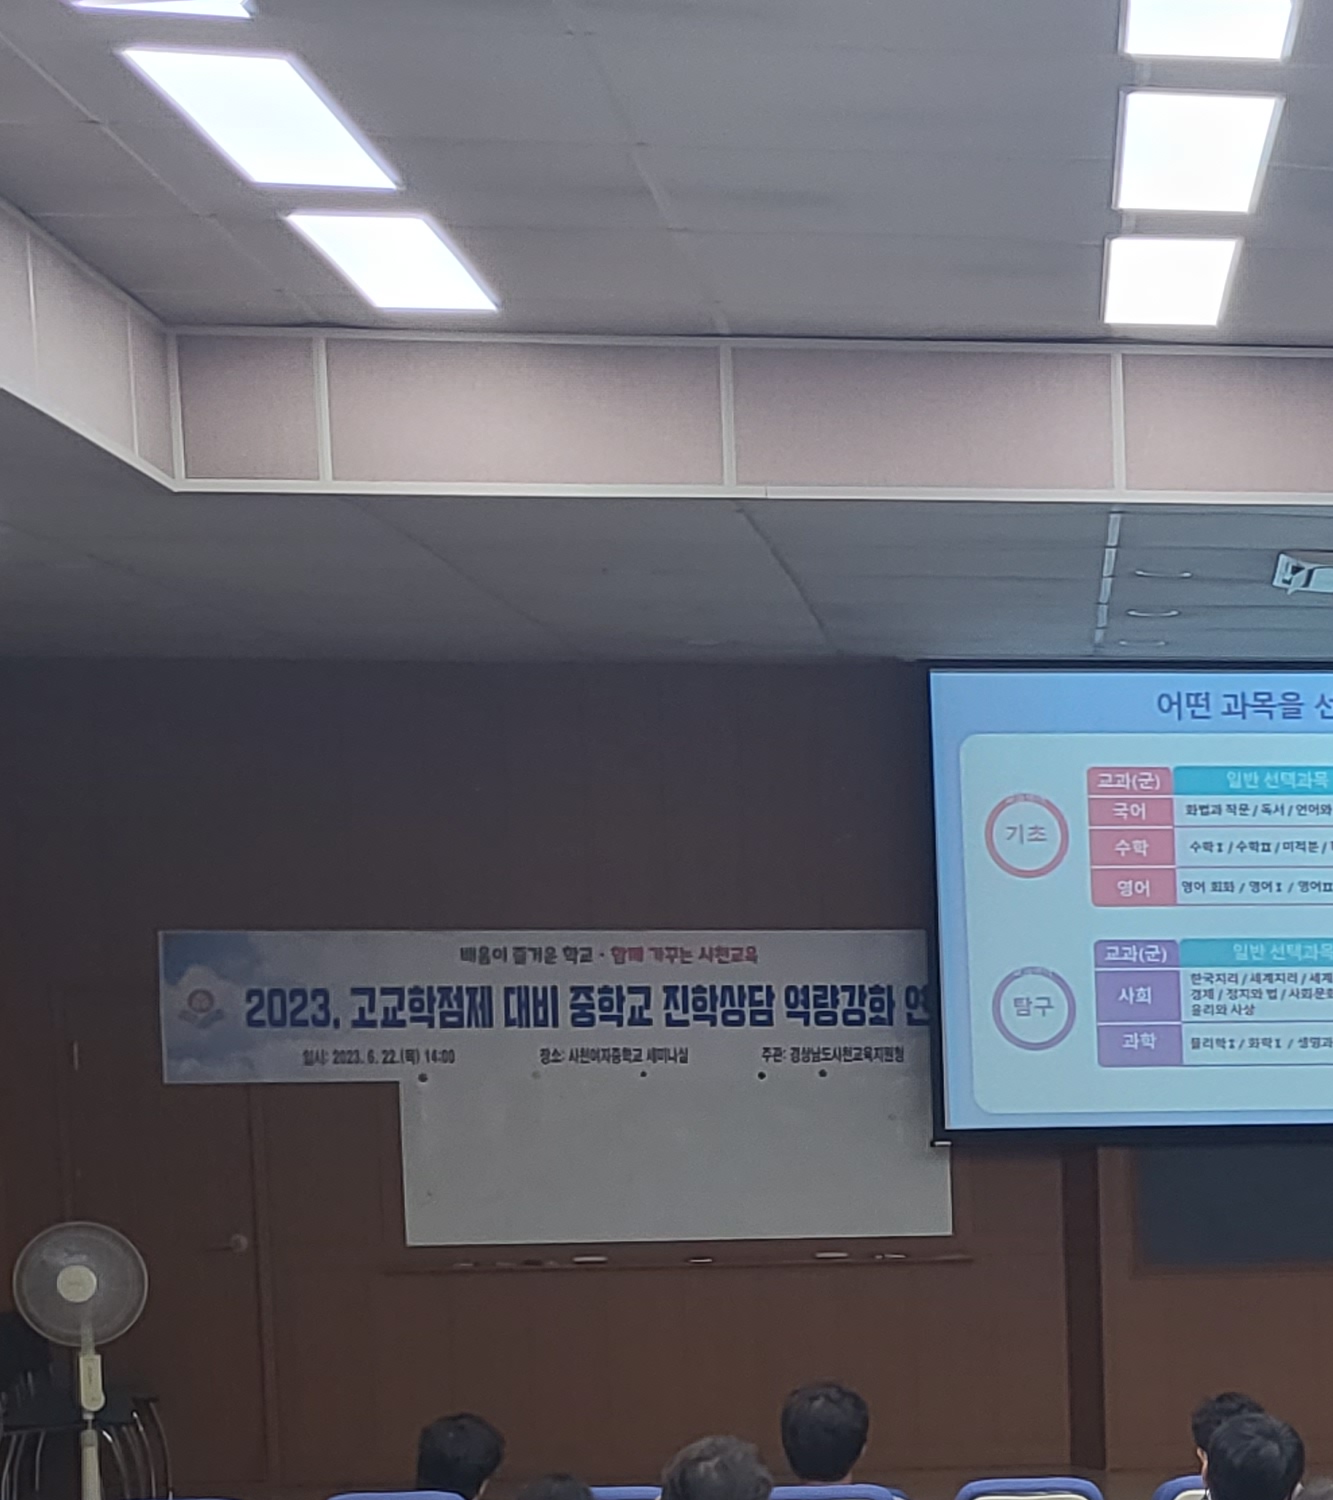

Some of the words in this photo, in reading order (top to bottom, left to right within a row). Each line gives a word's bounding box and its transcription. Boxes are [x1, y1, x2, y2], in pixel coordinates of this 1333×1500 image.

[1156, 692, 1212, 721] 어떤
[1220, 692, 1305, 721] 과목을
[1096, 772, 1162, 792] 교과(군)
[1225, 771, 1260, 790] 일반
[1262, 771, 1331, 790] 선택과목
[1111, 802, 1148, 821] 국어
[1005, 824, 1048, 845] 기초
[1113, 839, 1150, 858] 수학
[1116, 879, 1152, 898] 영어
[459, 946, 508, 965] 배움이
[511, 946, 558, 965] 즐거운
[561, 946, 594, 965] 학교
[610, 946, 645, 965] 함께
[648, 946, 694, 965] 가꾸는
[698, 946, 758, 965] 사천교육
[1103, 945, 1169, 964] 교과(군)
[1232, 943, 1266, 962] 일반
[1118, 986, 1153, 1006] 사회
[245, 986, 341, 1029] 2023.
[350, 984, 494, 1029] 고교학점제
[503, 984, 560, 1029] 대비
[569, 984, 654, 1028] 중학교
[662, 984, 776, 1028] 진학상담
[783, 984, 896, 1027] 역량강화
[1013, 996, 1055, 1017] 탐구
[1121, 1032, 1158, 1050] 과학
[424, 1048, 456, 1066] 14:00
[646, 1047, 690, 1065] 세미나실
[761, 1046, 787, 1064] 주관:
